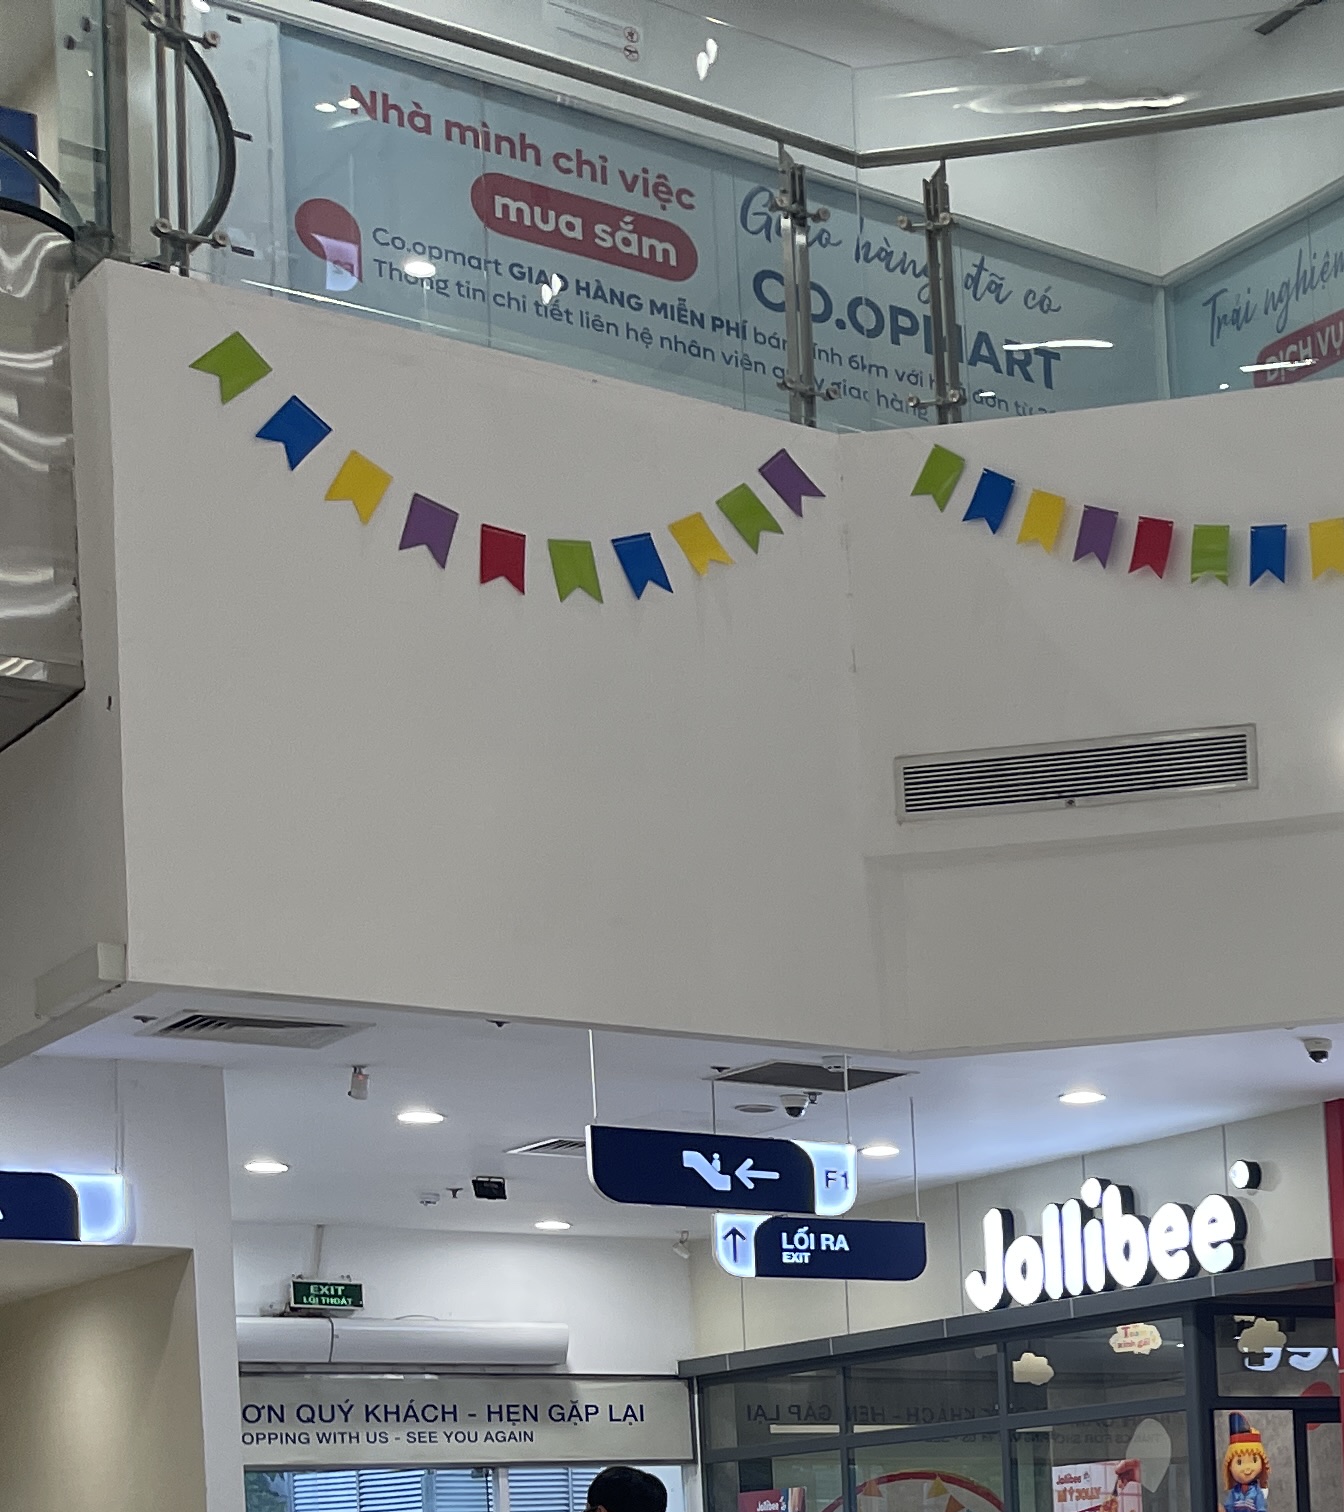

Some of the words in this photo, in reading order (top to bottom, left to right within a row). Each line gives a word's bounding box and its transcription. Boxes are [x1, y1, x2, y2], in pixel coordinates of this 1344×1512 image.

[350, 84, 432, 136] Nhà
[444, 119, 542, 167] mình
[552, 149, 608, 185] chỉ
[618, 167, 696, 211] việc
[494, 194, 583, 241] mua
[594, 215, 678, 267] sắm
[740, 186, 842, 248] Go
[1024, 286, 1062, 314] có
[372, 227, 503, 276] Co.opmart
[575, 278, 643, 311] HÀNG
[650, 297, 705, 329] MIỄN
[711, 315, 748, 341] PHÍ
[812, 343, 842, 368] ính
[455, 282, 486, 303] tin
[492, 289, 527, 313] chi
[533, 299, 574, 326] tiết
[580, 309, 619, 337] liên
[626, 322, 653, 348] hệ
[660, 334, 715, 363] nhân
[722, 350, 766, 376] viên
[824, 1169, 849, 1189] F1
[782, 1226, 815, 1250] LỐI
[820, 1233, 850, 1251] RA
[782, 1252, 811, 1263] EXIT
[964, 1177, 1247, 1312] Jollibee
[309, 1284, 345, 1296] EXIT
[296, 1398, 354, 1426] QUÝ
[364, 1398, 458, 1424] KHÁCH
[487, 1403, 538, 1427] HẸN
[548, 1399, 600, 1427] GẶP
[608, 1403, 645, 1427] LẠI
[316, 1431, 360, 1445] WITH
[366, 1431, 389, 1444] US
[406, 1431, 438, 1444] SEE
[443, 1431, 479, 1444] YOU
[483, 1431, 534, 1444] AGAIN
